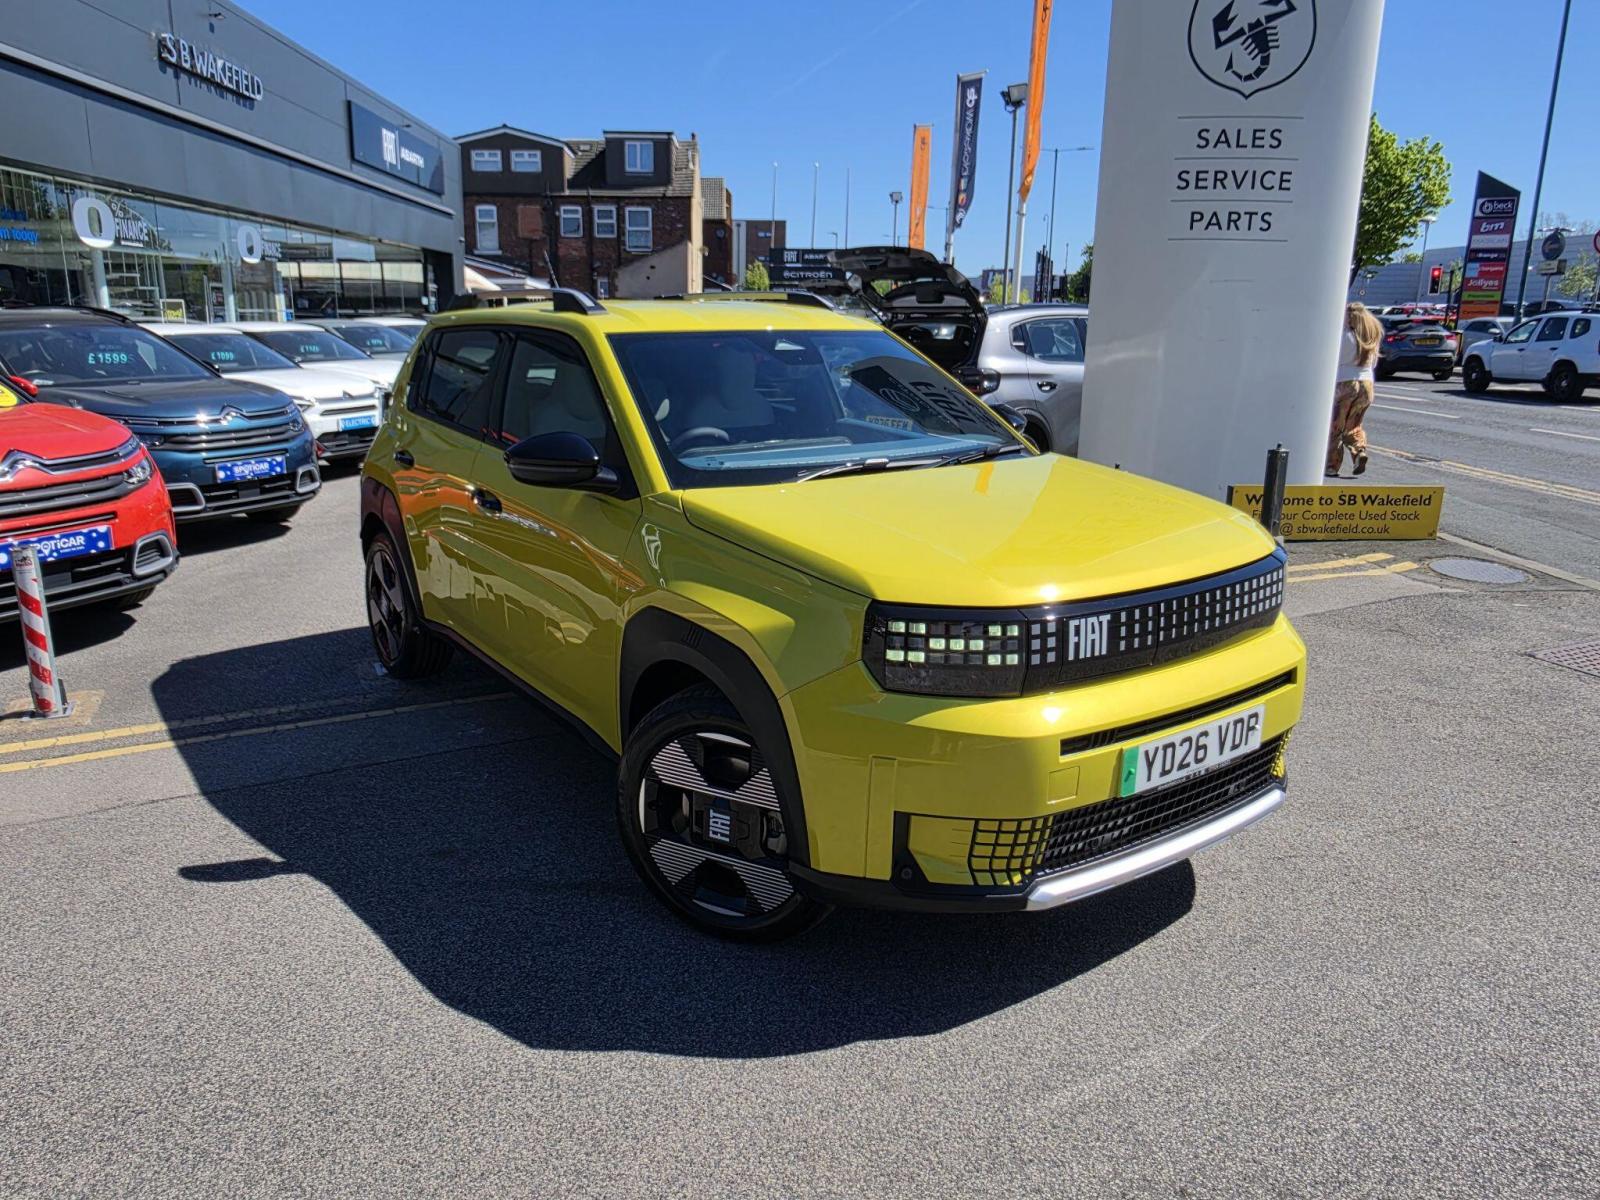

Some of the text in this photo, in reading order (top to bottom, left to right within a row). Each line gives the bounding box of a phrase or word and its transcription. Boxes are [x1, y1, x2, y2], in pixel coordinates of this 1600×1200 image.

[193, 44, 263, 101] WAKEFIELD
[1196, 128, 1283, 149] SALES
[1176, 170, 1292, 191] SERVICE
[115, 218, 149, 241] FINANCE
[1189, 211, 1272, 232] PARTS
[88, 352, 128, 364] £1599
[1245, 493, 1432, 506] Wome to SB Wakefield
[1302, 510, 1355, 523] Complete
[1359, 511, 1387, 521] Used
[1390, 510, 1420, 521] Stock
[1280, 522, 1390, 536] @ sbwakefield.co.uk
[1068, 614, 1111, 661] FIAT
[1144, 730, 1209, 783] YD26
[709, 808, 731, 842] FIAT
